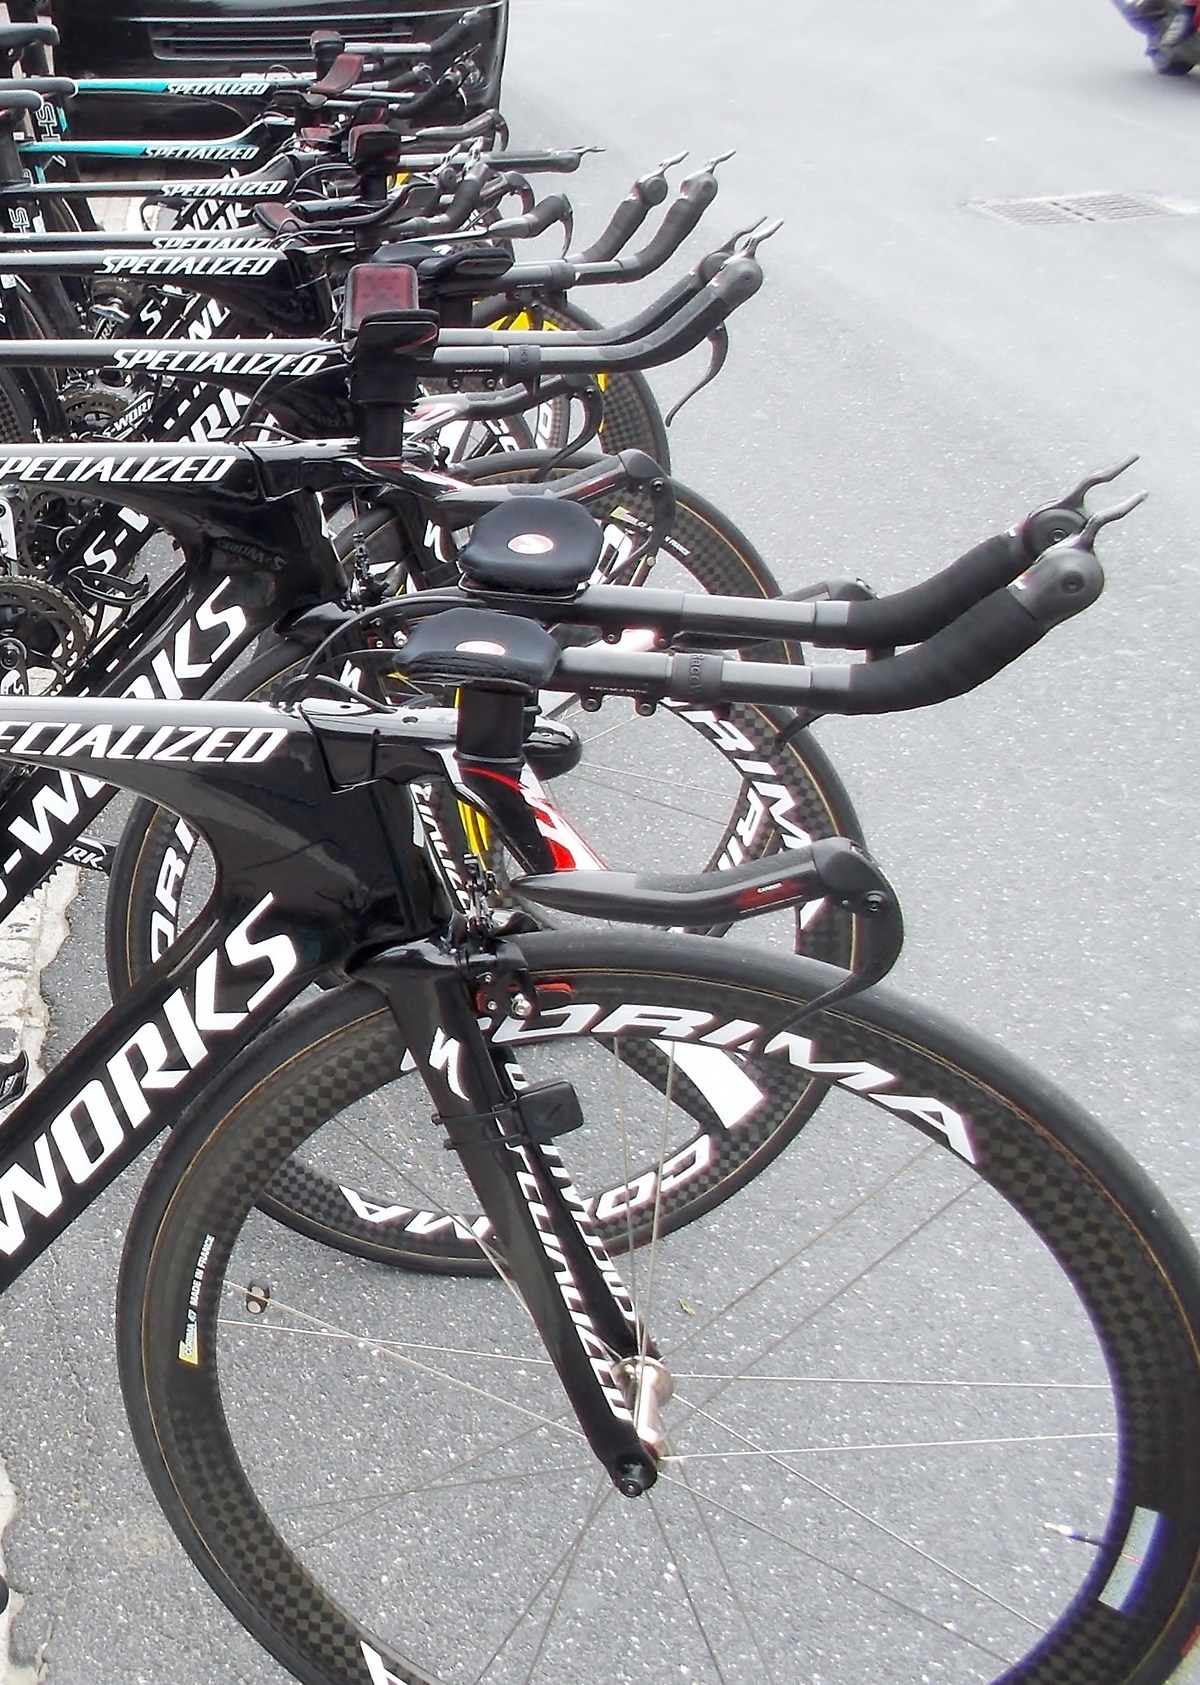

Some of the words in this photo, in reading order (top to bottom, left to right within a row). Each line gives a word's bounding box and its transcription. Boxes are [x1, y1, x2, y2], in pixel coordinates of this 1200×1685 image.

[167, 82, 271, 96] SPECIALIZED
[145, 146, 259, 160] SPECIALIZED
[160, 180, 288, 197] SPECIALIZED
[94, 255, 278, 276] SPECIALIZED
[103, 349, 328, 377] SPECIALIZED
[197, 1234, 216, 1269] FRANCE
[194, 1268, 205, 1280] IN
[189, 1279, 202, 1307] MADE
